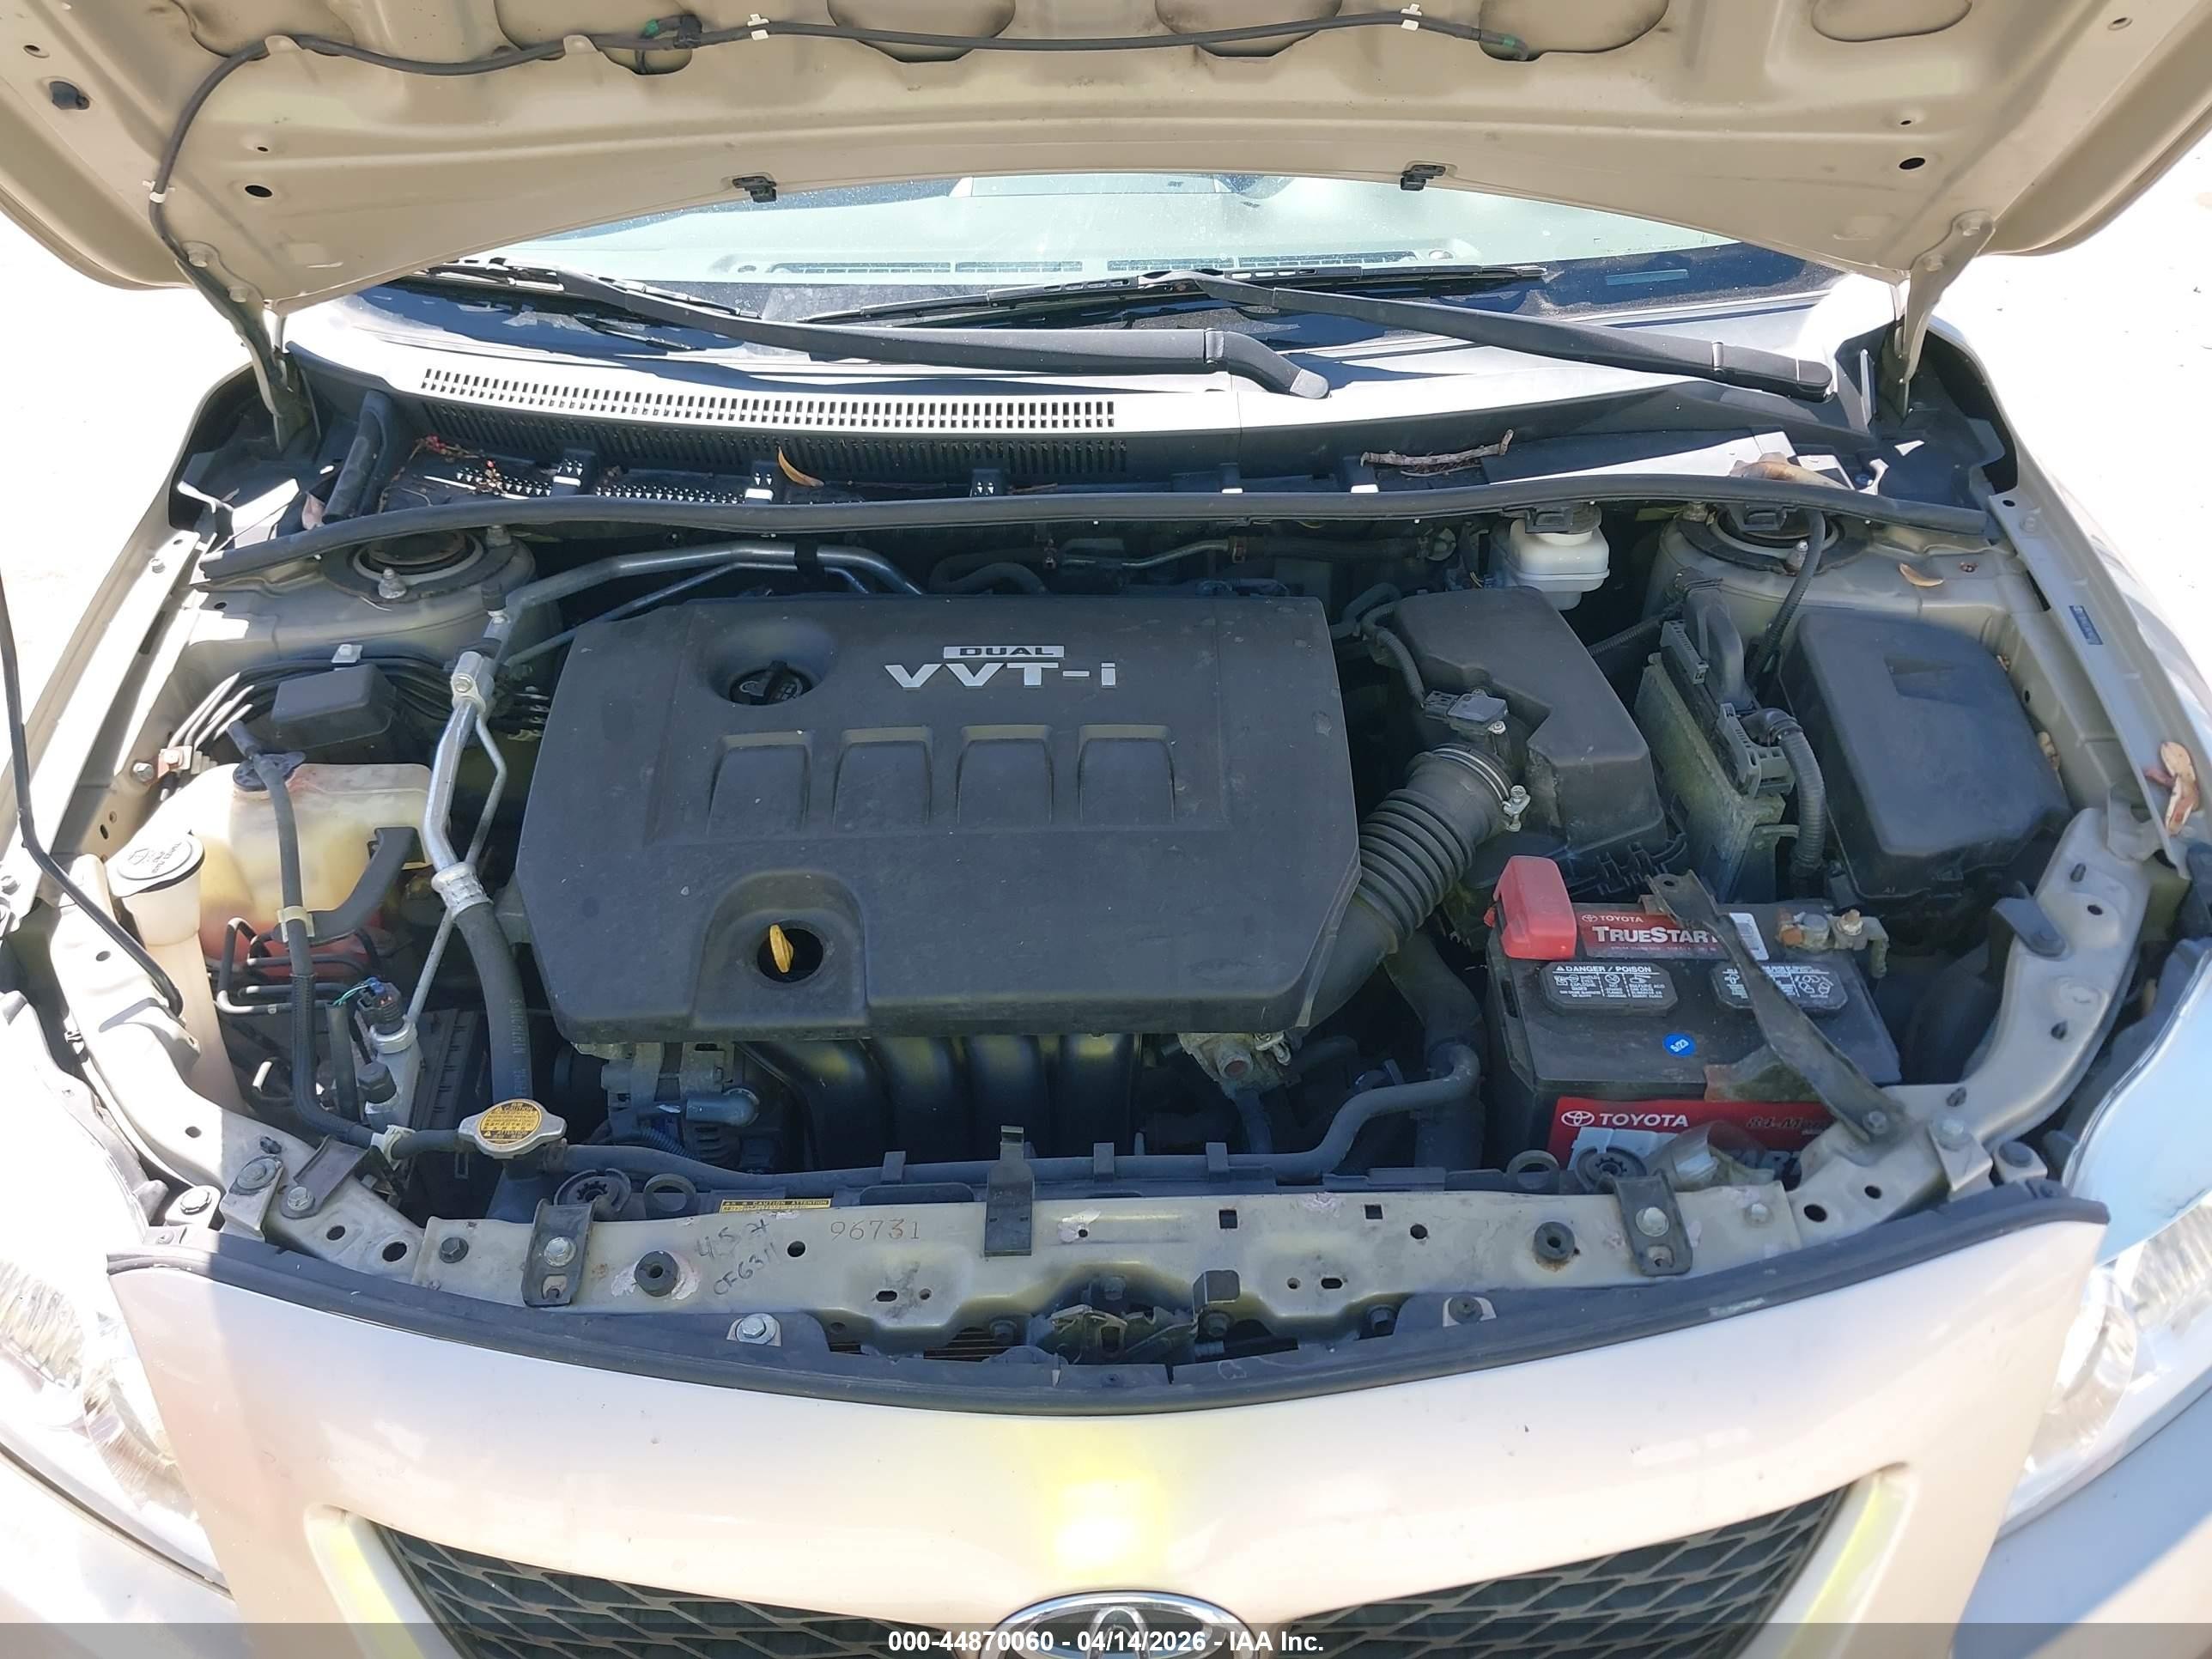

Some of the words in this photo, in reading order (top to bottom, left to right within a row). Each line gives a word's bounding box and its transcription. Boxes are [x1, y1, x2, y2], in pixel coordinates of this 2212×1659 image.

[959, 647, 1054, 656] DUAL
[884, 662, 1116, 688] VVT-i
[1599, 1113, 1690, 1127] TOYOTA
[830, 1218, 921, 1241] 96731
